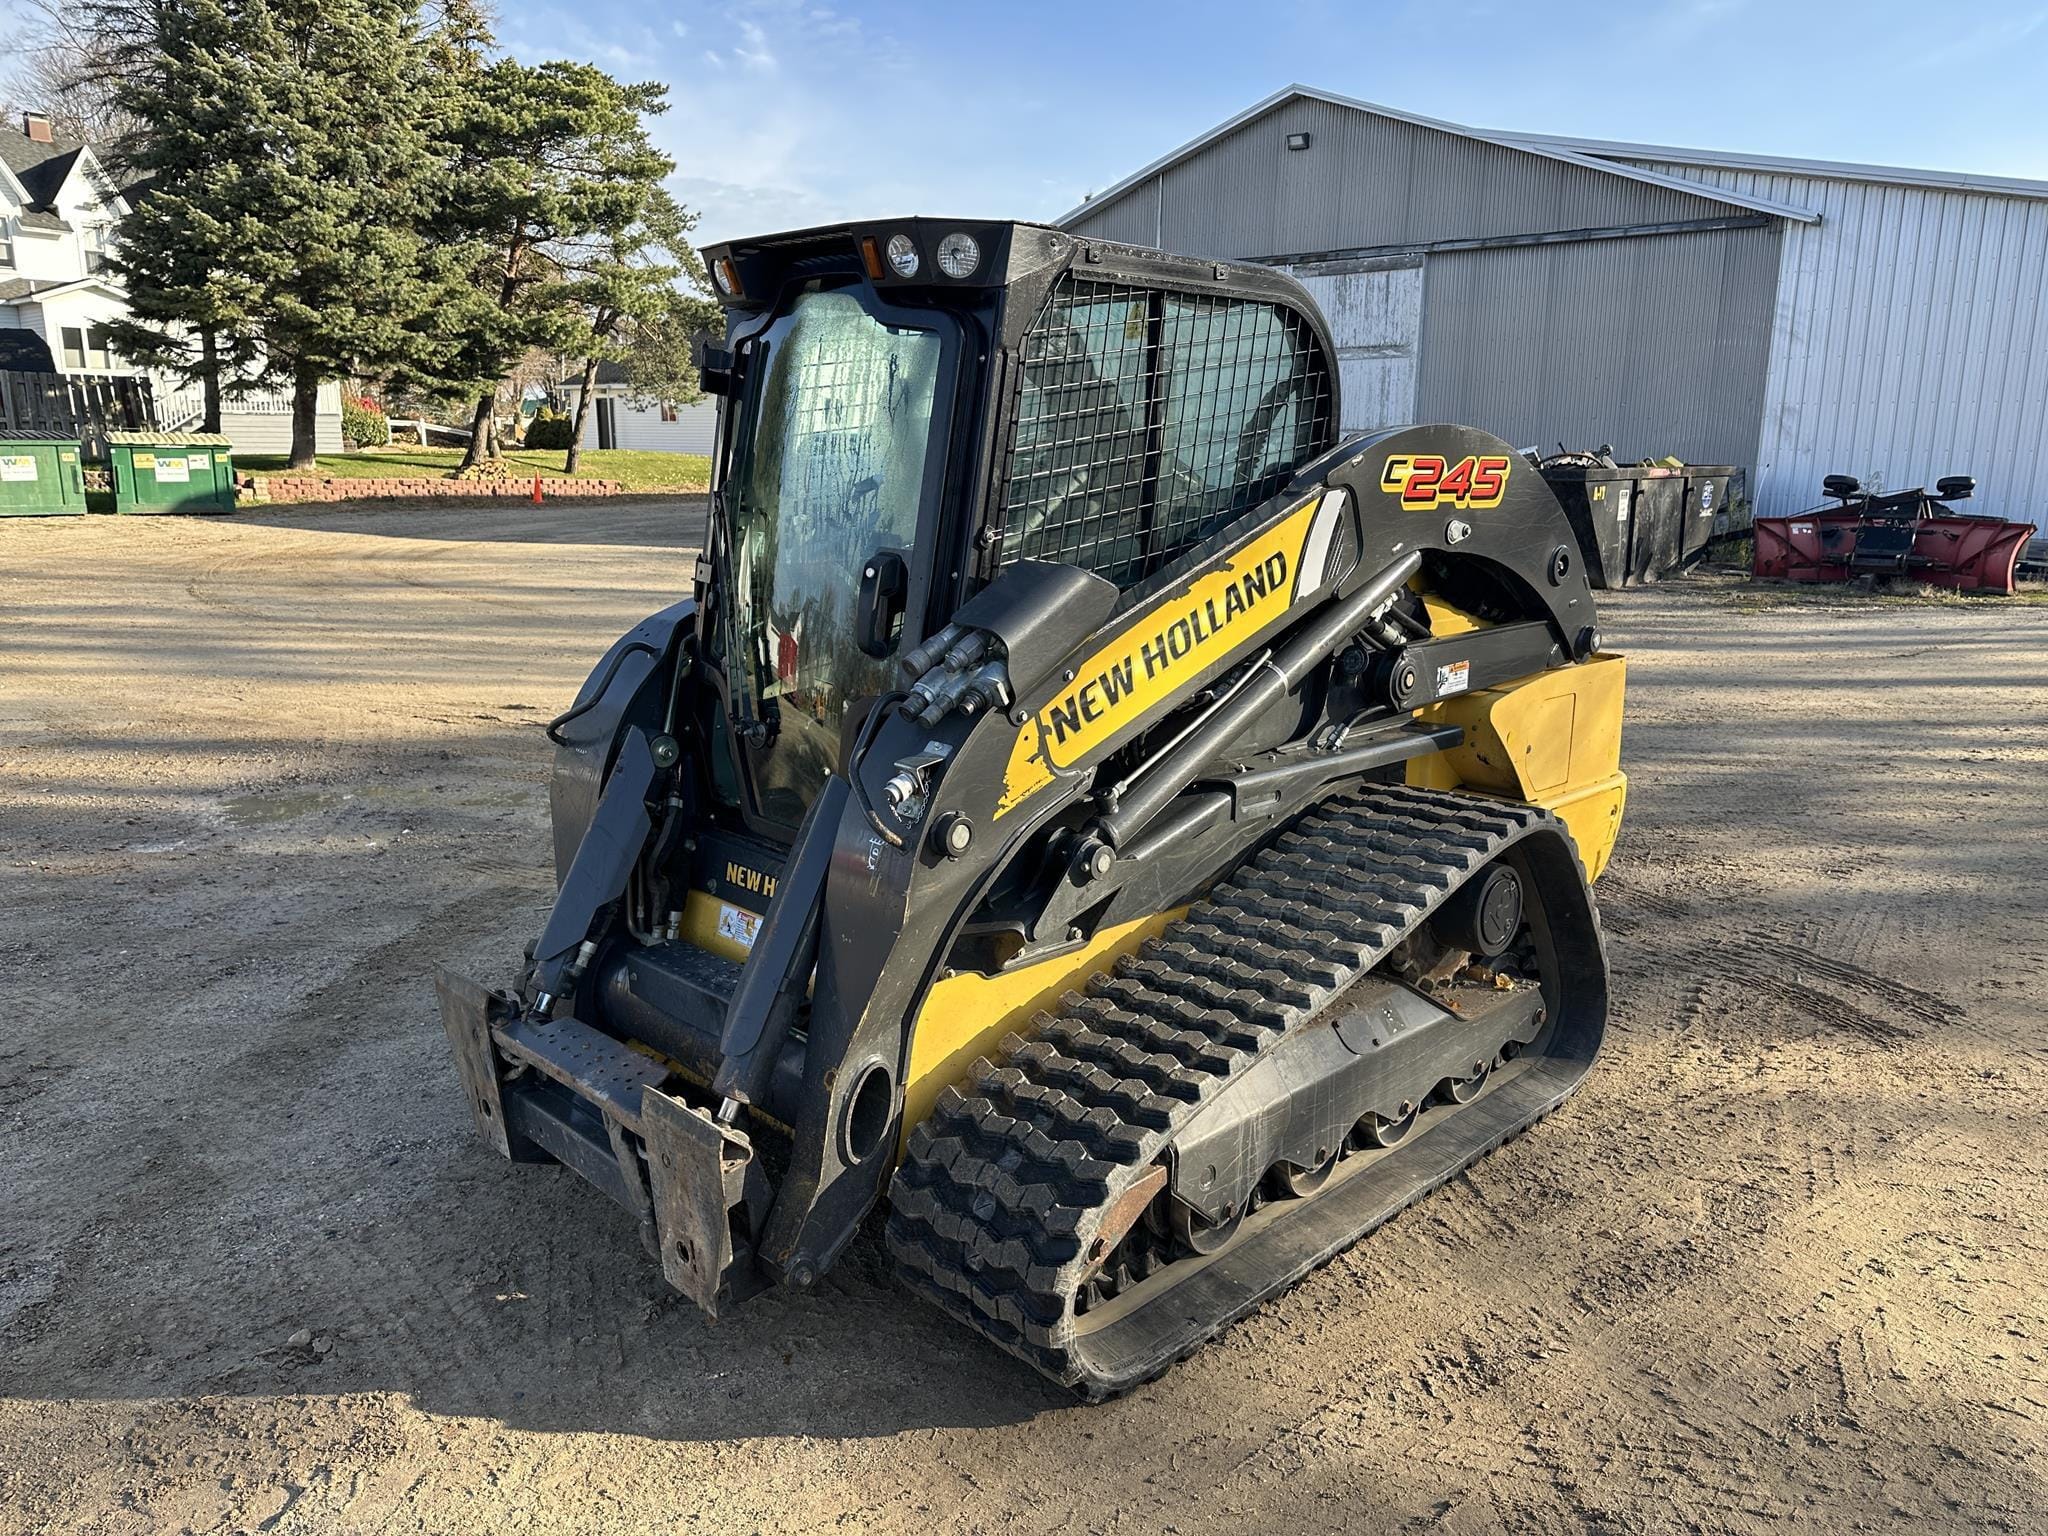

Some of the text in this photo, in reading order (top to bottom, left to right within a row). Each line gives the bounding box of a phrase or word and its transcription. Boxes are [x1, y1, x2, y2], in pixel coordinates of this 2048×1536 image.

[1382, 456, 1510, 508] C245
[1050, 550, 1288, 745] NEW HOLLAND
[726, 862, 779, 897] NEW H
